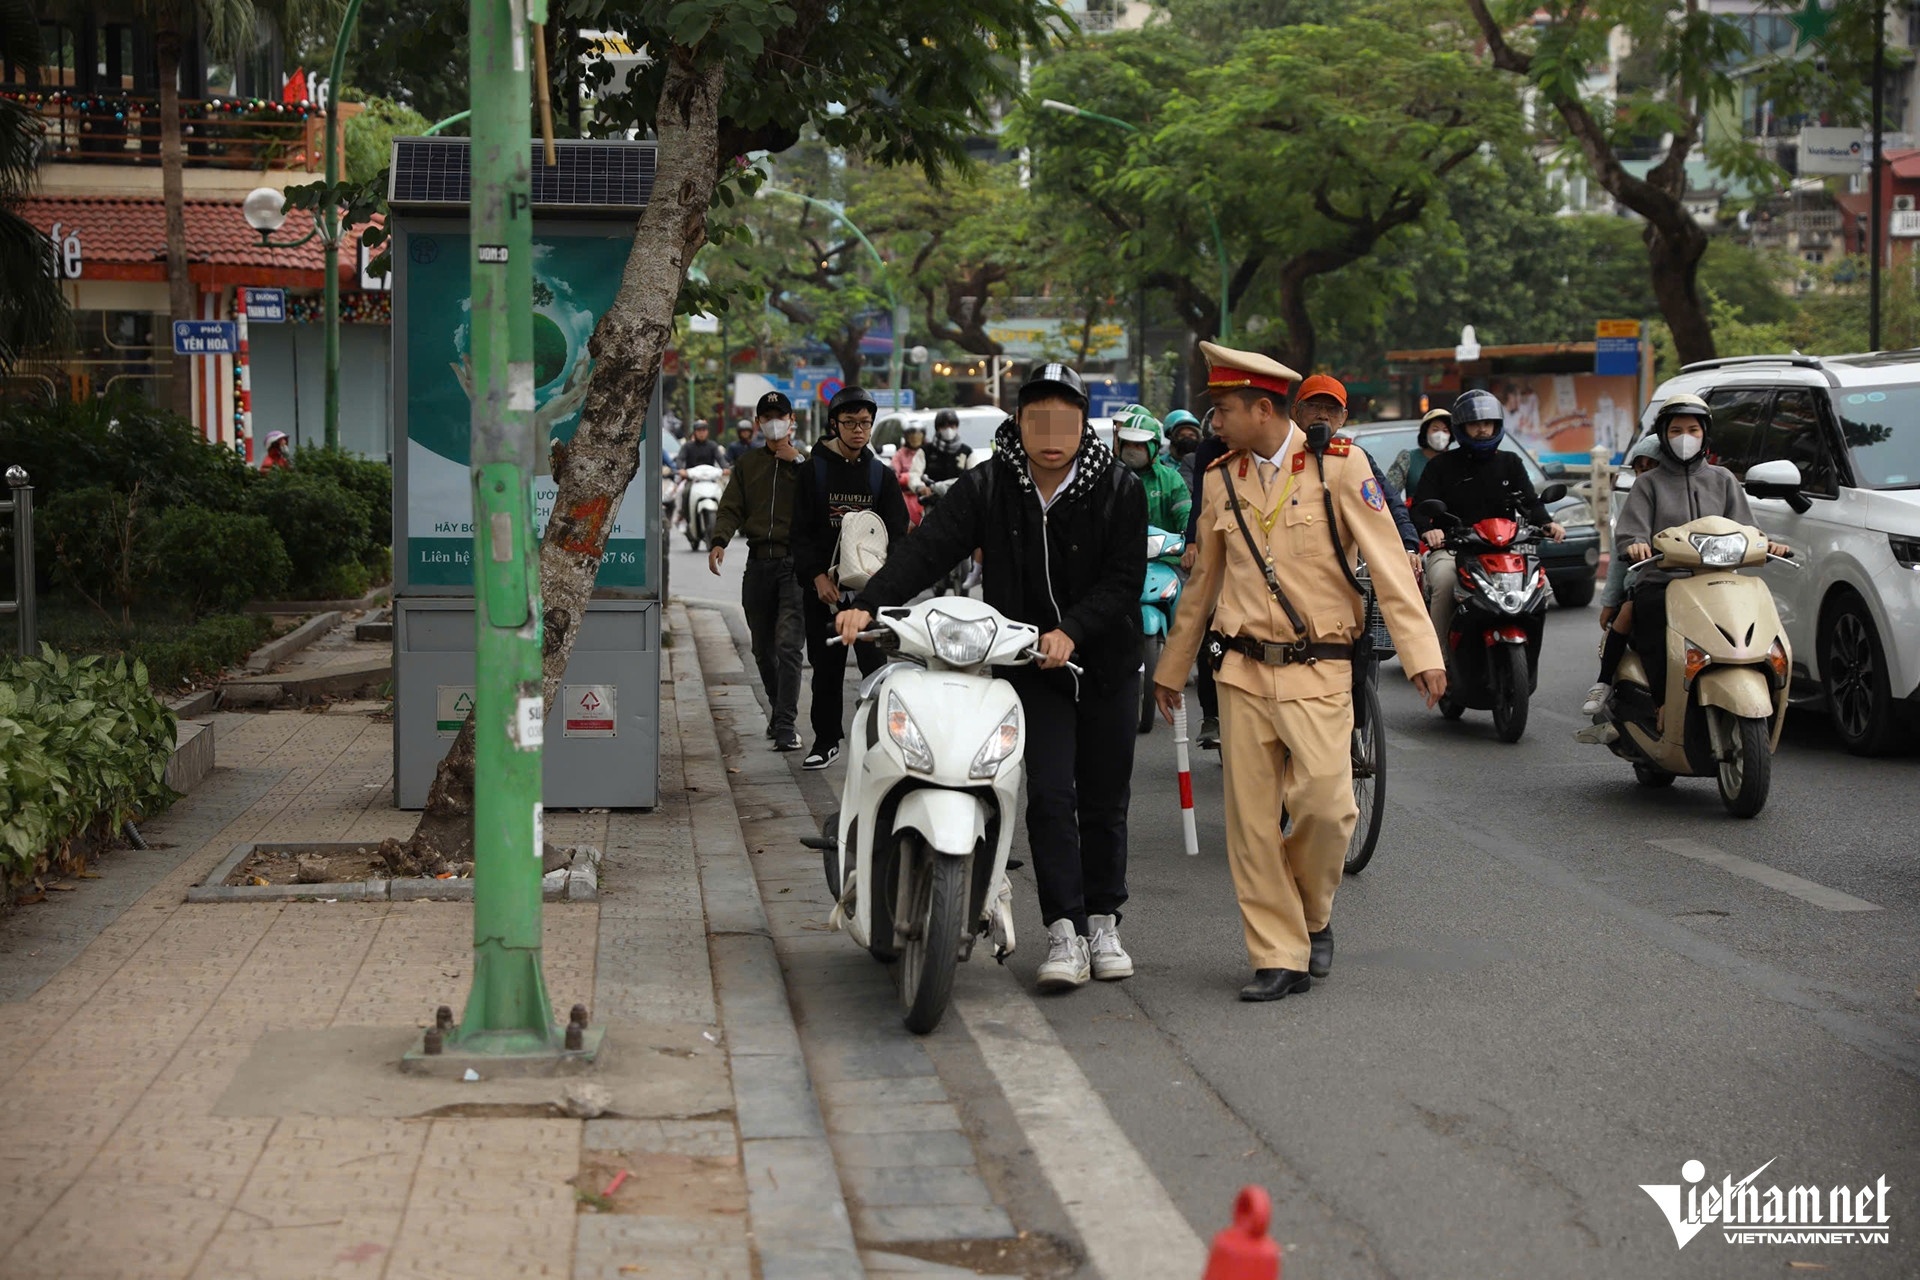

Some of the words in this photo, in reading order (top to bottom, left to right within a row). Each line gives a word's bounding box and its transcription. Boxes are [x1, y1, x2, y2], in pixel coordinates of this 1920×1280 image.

[183, 336, 204, 350] YÊN
[435, 521, 458, 532] HÃY
[421, 551, 450, 563] Liên
[455, 551, 470, 565] hệ
[620, 552, 635, 564] 86
